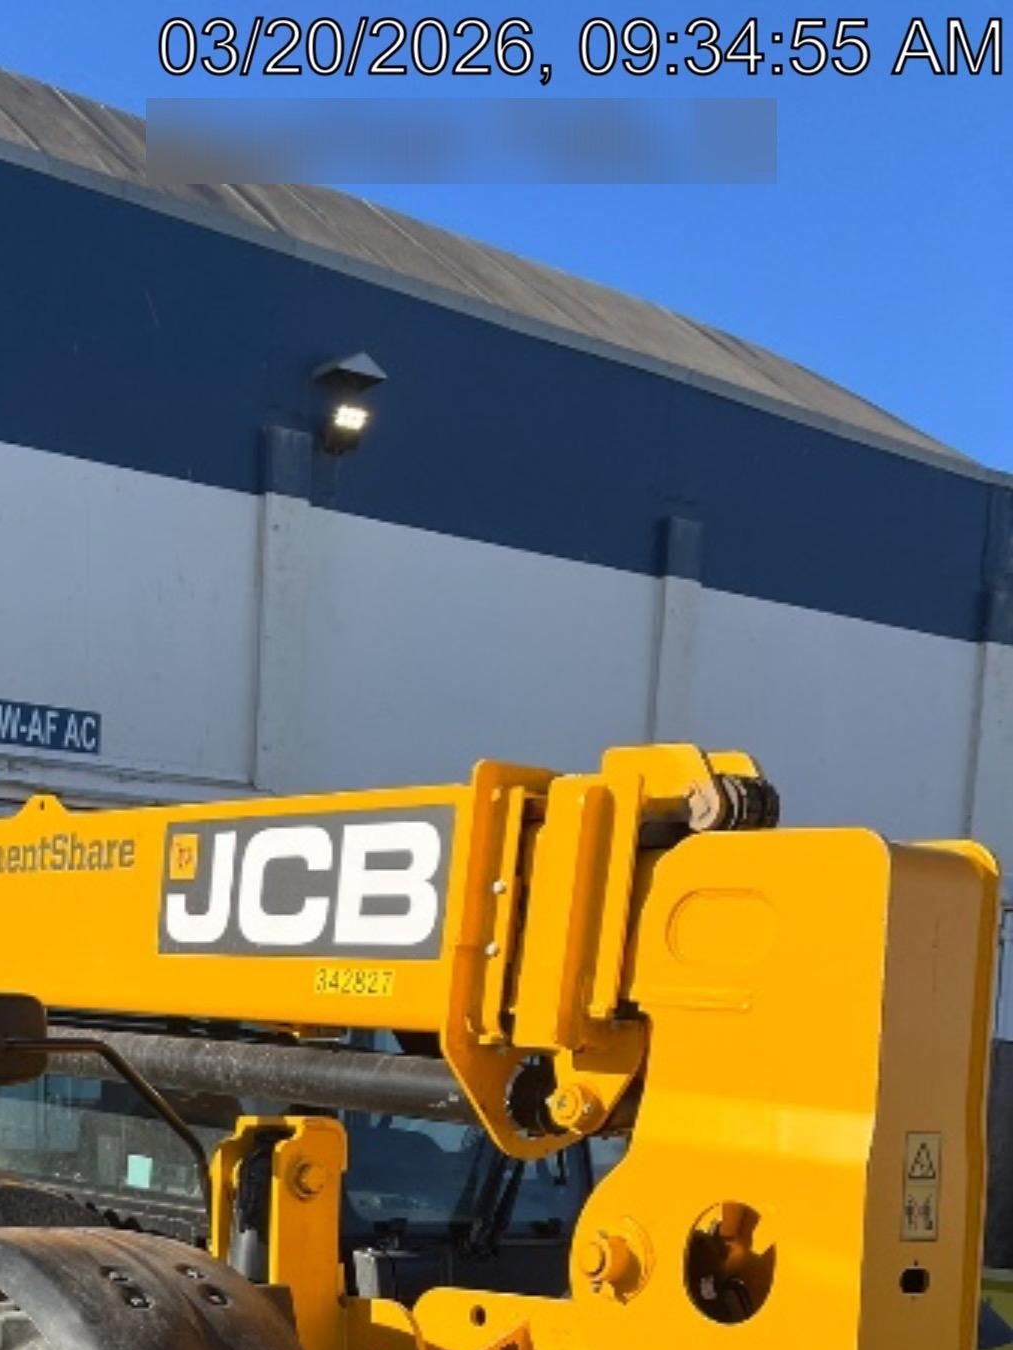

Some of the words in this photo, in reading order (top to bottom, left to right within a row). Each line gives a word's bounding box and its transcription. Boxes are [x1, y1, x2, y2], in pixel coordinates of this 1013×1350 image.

[64, 712, 96, 751] AC
[166, 821, 441, 946] JCB
[316, 968, 393, 993] 342827
